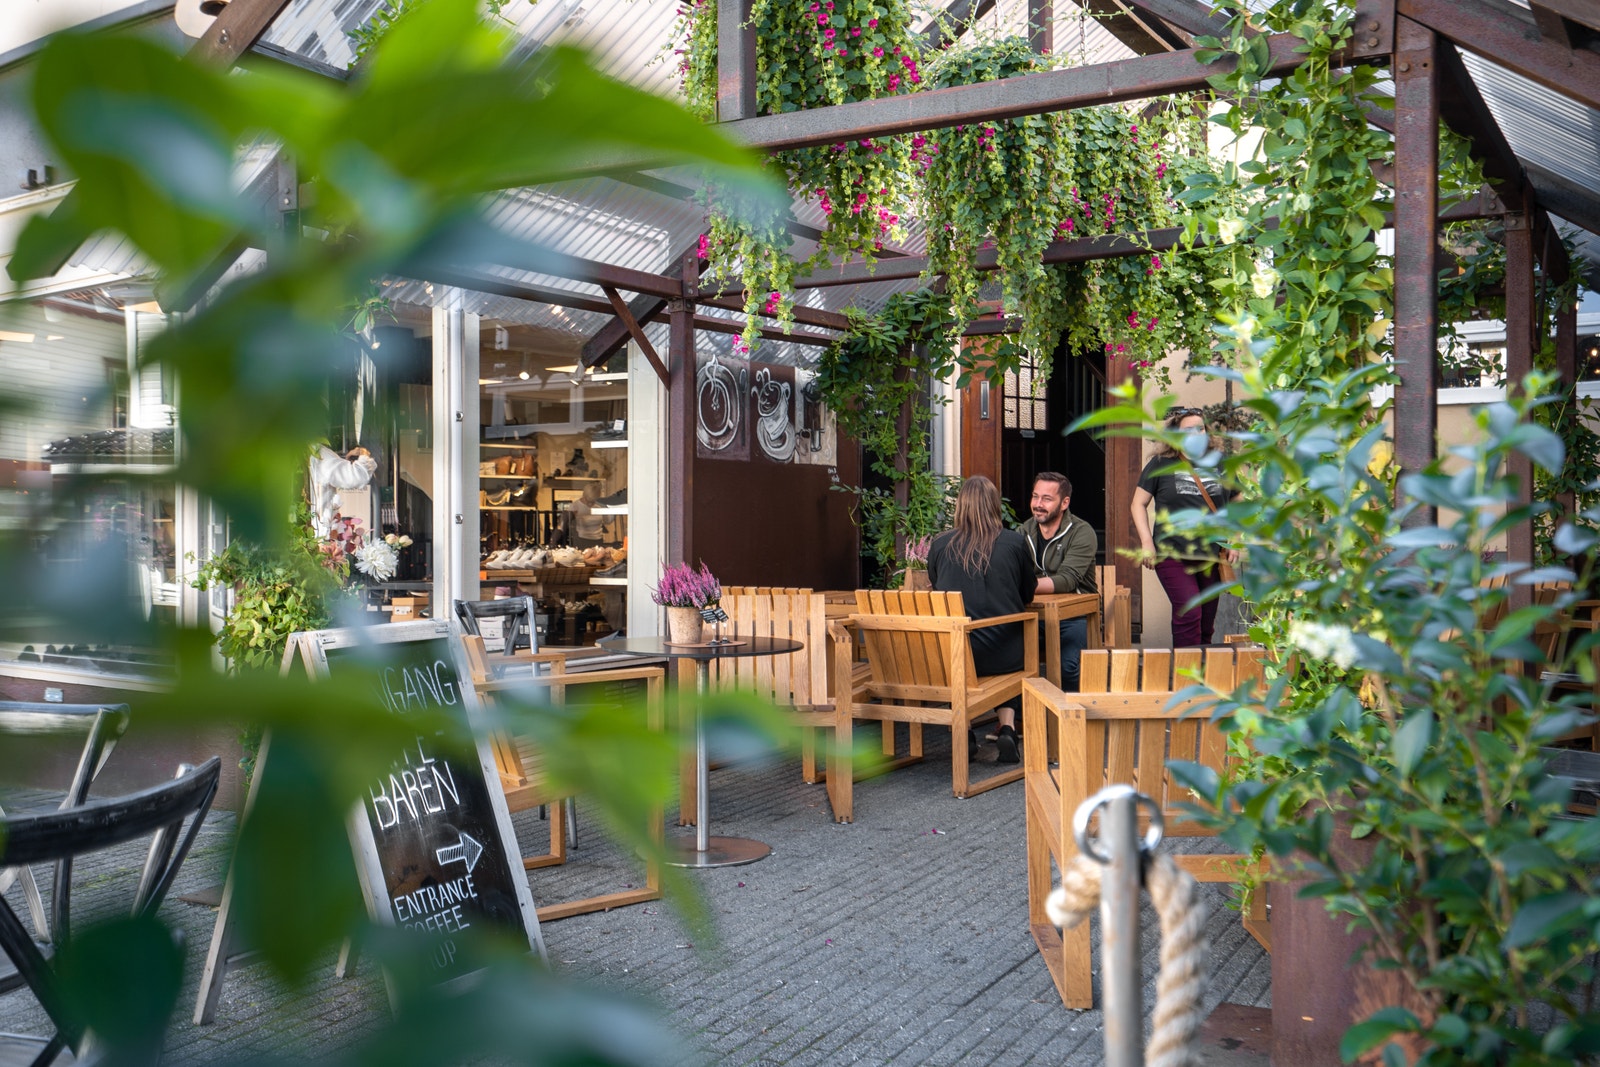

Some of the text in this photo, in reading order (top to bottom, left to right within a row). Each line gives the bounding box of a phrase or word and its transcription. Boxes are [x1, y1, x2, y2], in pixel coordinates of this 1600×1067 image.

[373, 660, 457, 713] NGANG
[369, 761, 460, 830] BAREN
[394, 874, 478, 922] ENTRANCE
[404, 905, 470, 935] OFFEE
